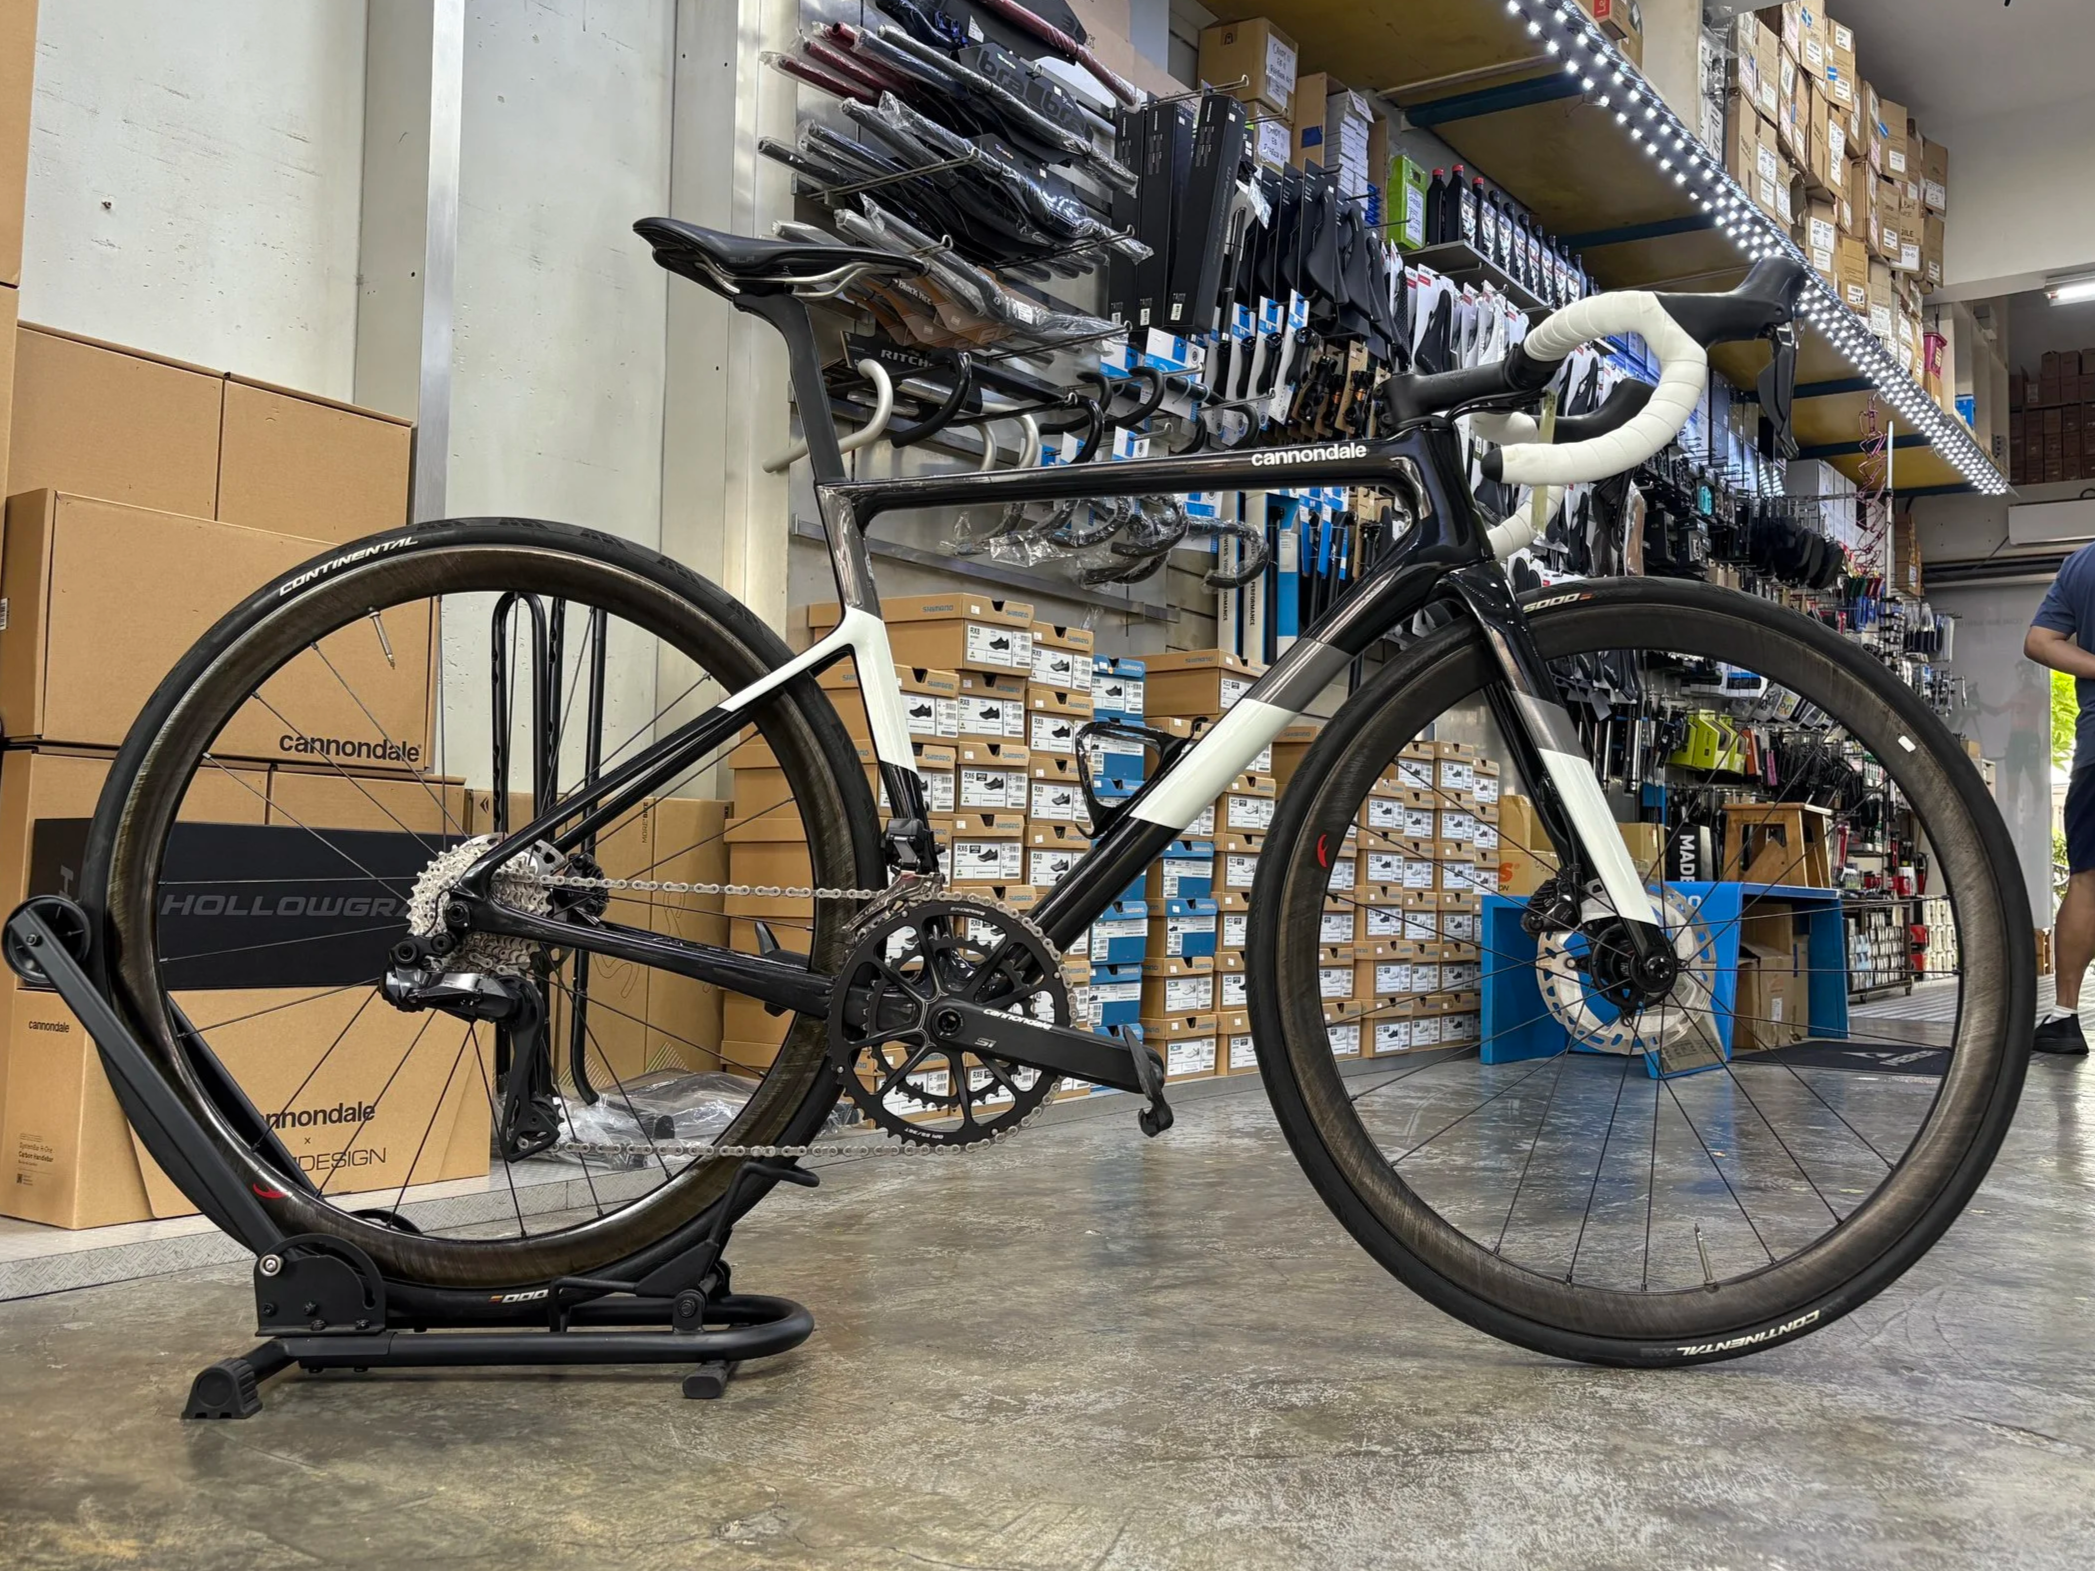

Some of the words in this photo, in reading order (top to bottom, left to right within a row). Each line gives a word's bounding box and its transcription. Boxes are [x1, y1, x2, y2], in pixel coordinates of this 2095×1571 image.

[1251, 442, 1367, 466] cannondale
[279, 537, 419, 596] CONTINENTAL
[922, 604, 954, 613] SHIMANO
[279, 734, 420, 762] cannondale
[28, 1020, 69, 1033] cannondale
[983, 1008, 1053, 1031] cannondale
[1676, 1309, 1820, 1356] CONTINENTAL
